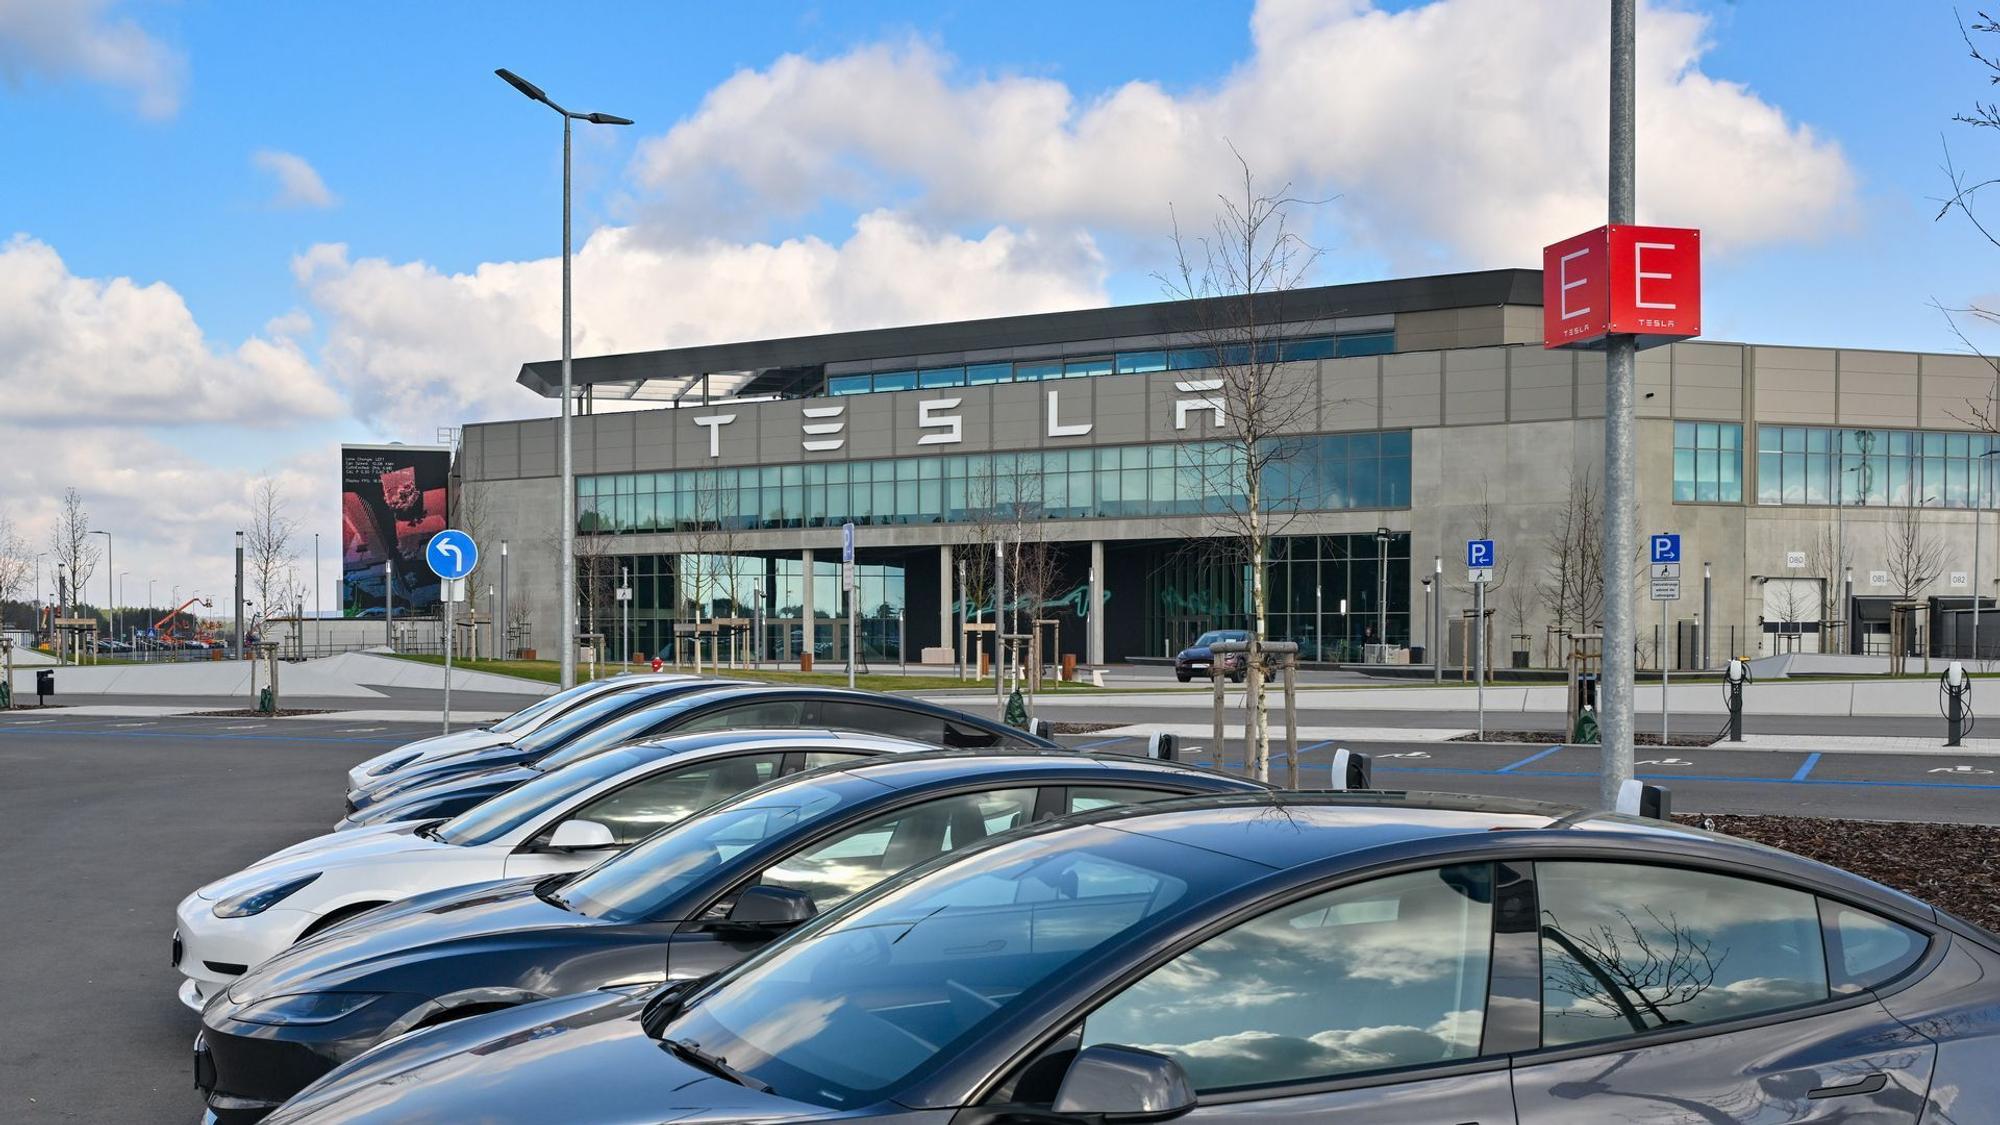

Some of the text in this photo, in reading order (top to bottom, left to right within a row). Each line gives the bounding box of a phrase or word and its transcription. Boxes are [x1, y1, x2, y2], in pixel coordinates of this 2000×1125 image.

[1561, 247, 1590, 321] E
[1634, 241, 1676, 310] E
[1564, 323, 1590, 337] TESLA
[1638, 319, 1675, 328] TESLA
[693, 379, 1226, 458] TESLA
[1472, 544, 1486, 563] P
[1656, 538, 1671, 559] P
[1872, 575, 1885, 583] 081
[1952, 576, 1966, 584] 082
